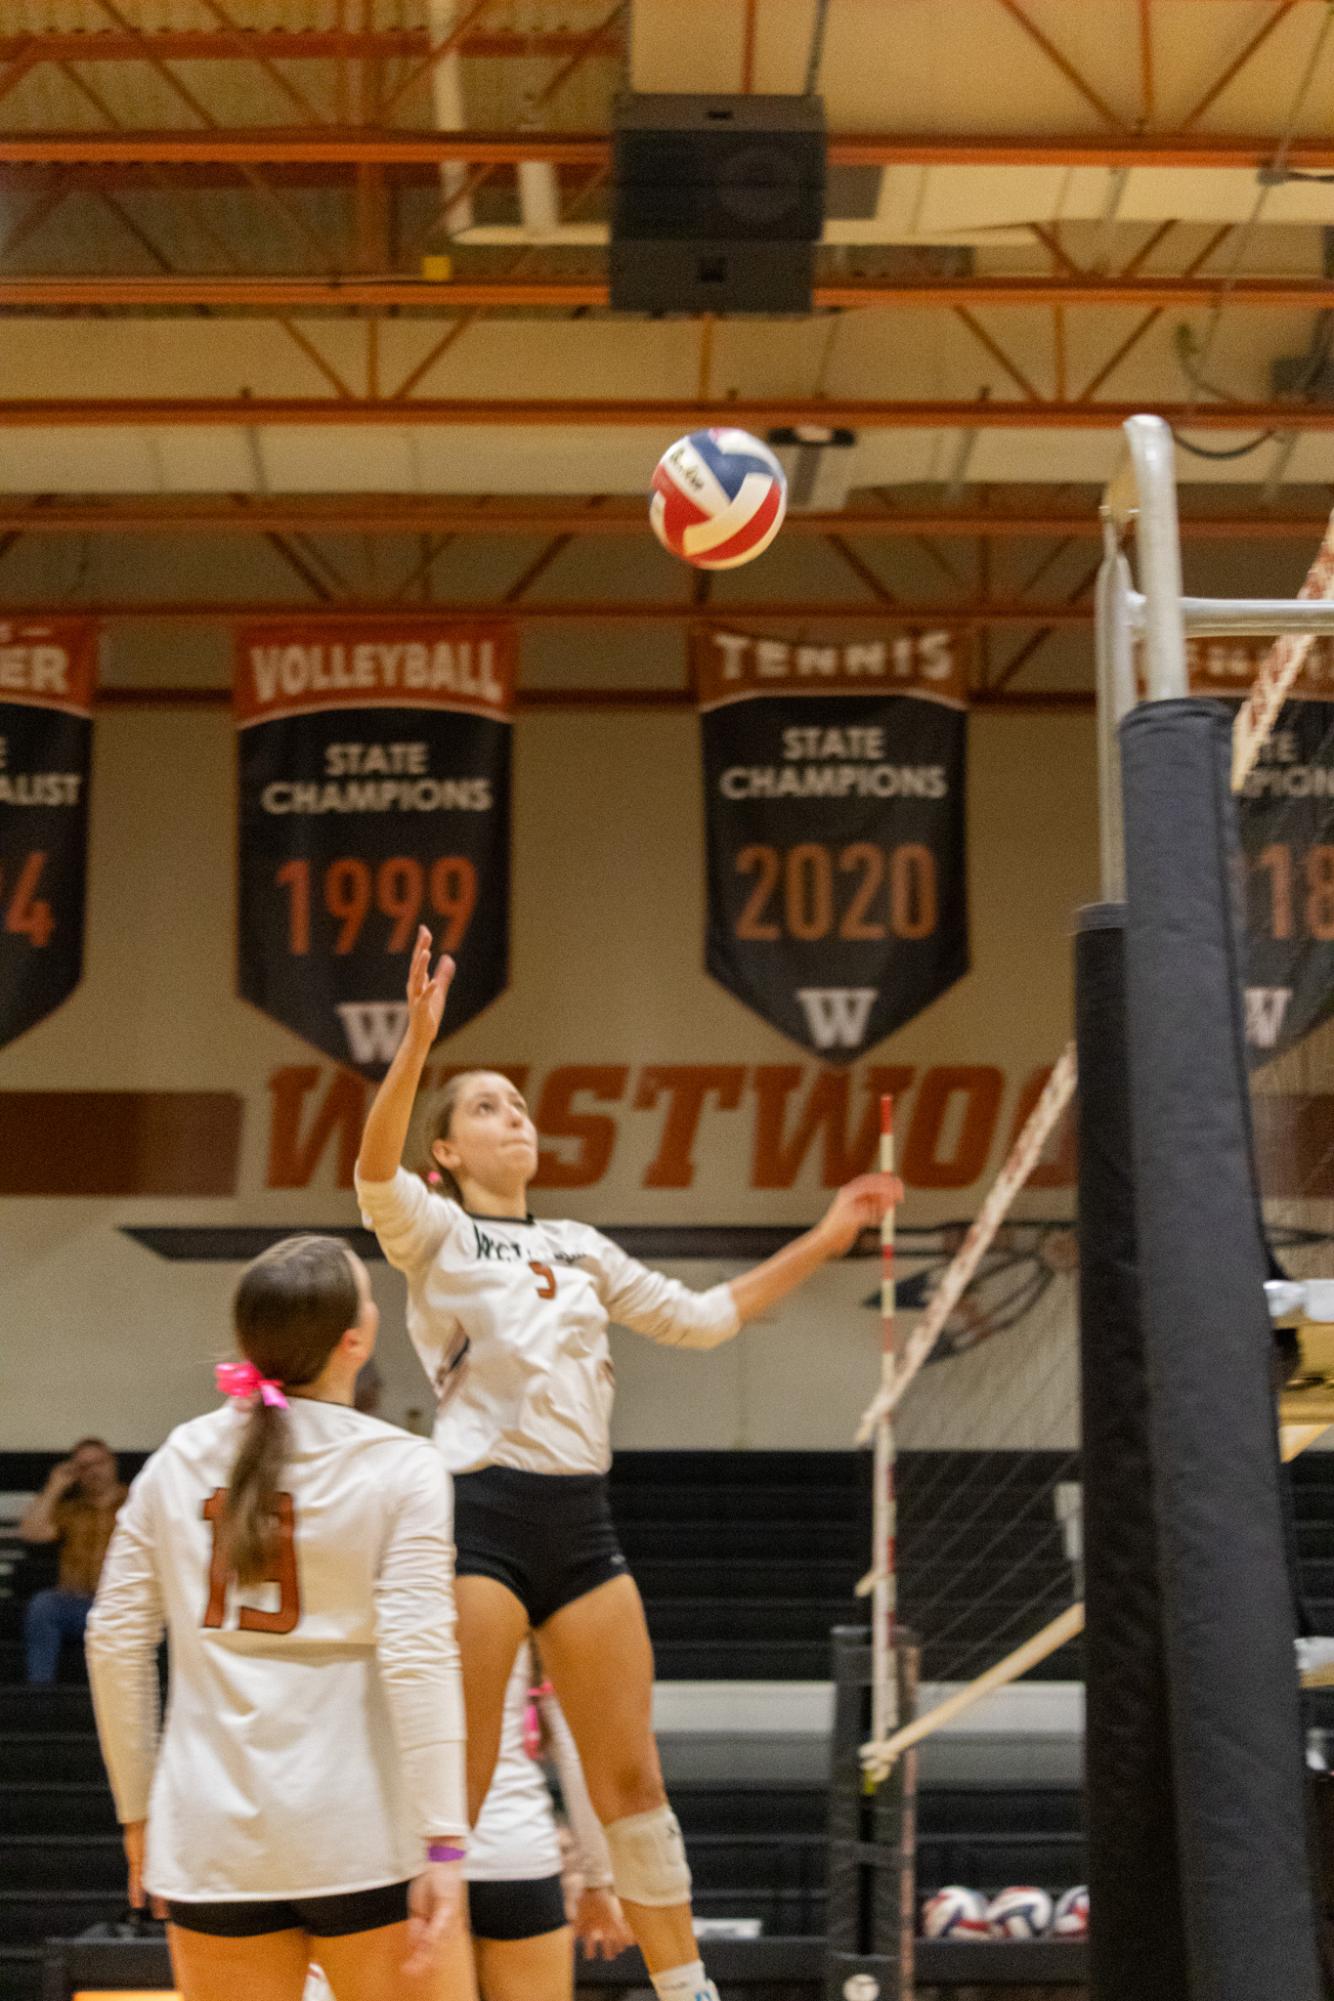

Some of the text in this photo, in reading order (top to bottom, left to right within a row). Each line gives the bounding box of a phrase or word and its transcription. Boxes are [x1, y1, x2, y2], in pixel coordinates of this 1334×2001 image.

[251, 641, 502, 702] VOLLEYBALL
[715, 630, 952, 680] TENNIS
[325, 743, 430, 776] STATE
[783, 726, 885, 761] STATE
[261, 777, 493, 815] CHAMPIONS
[720, 764, 949, 800] CHAMPIONS
[276, 856, 478, 956] 1999
[735, 842, 938, 940] 2020
[336, 1001, 408, 1063] W
[797, 987, 879, 1048] W
